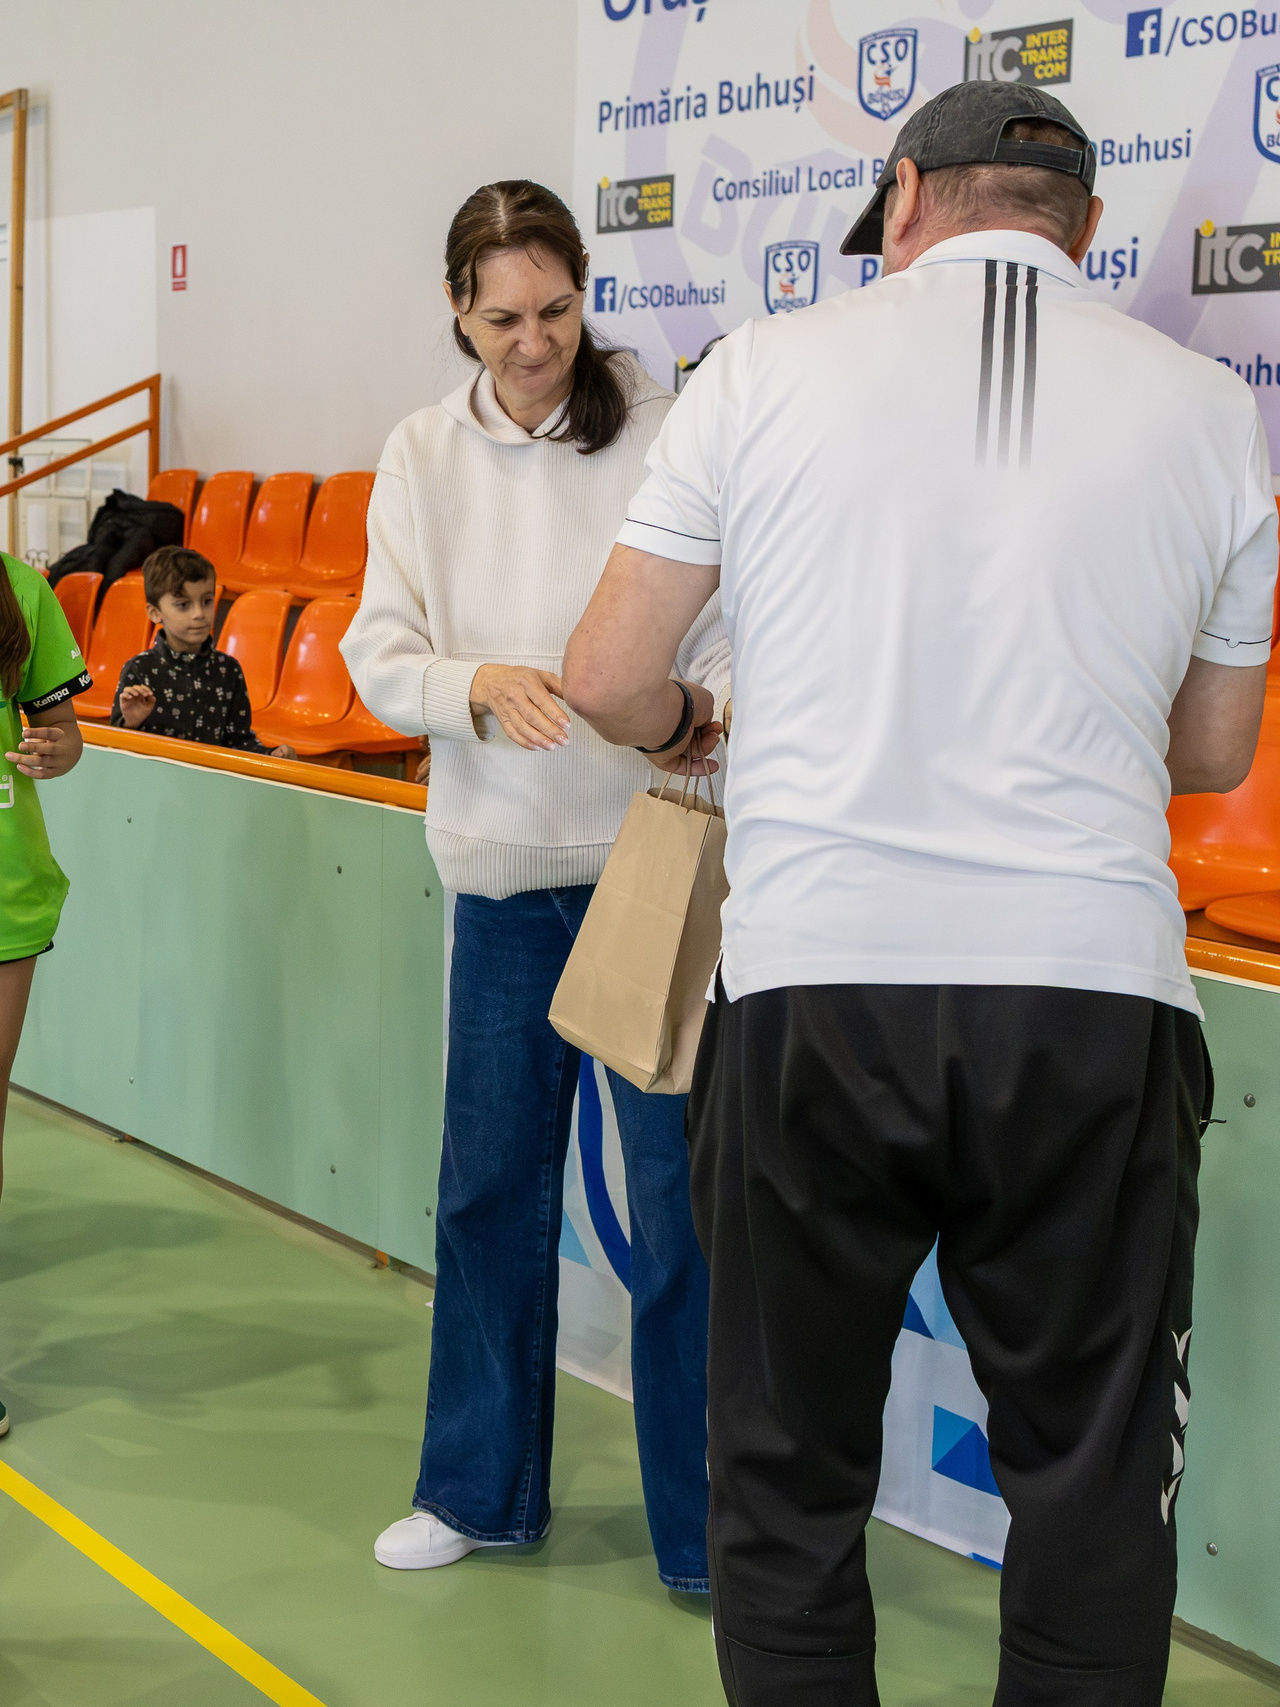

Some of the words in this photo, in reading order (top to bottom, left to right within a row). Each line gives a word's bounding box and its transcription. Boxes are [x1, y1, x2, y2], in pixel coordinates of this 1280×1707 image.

[1026, 29, 1068, 49] INTER
[867, 38, 908, 65] CSO
[1020, 45, 1068, 65] TRANS
[1034, 61, 1067, 79] COM
[598, 86, 707, 133] Primăria
[718, 65, 815, 113] Buhuși
[641, 182, 671, 196] INTER
[713, 165, 800, 202] Consiliul
[808, 159, 864, 191] Local
[637, 196, 671, 211] TRANS
[646, 209, 671, 223] COM
[773, 250, 811, 273] CSO
[618, 280, 725, 314] /CSOBuhusi
[33, 688, 70, 708] Kempa
